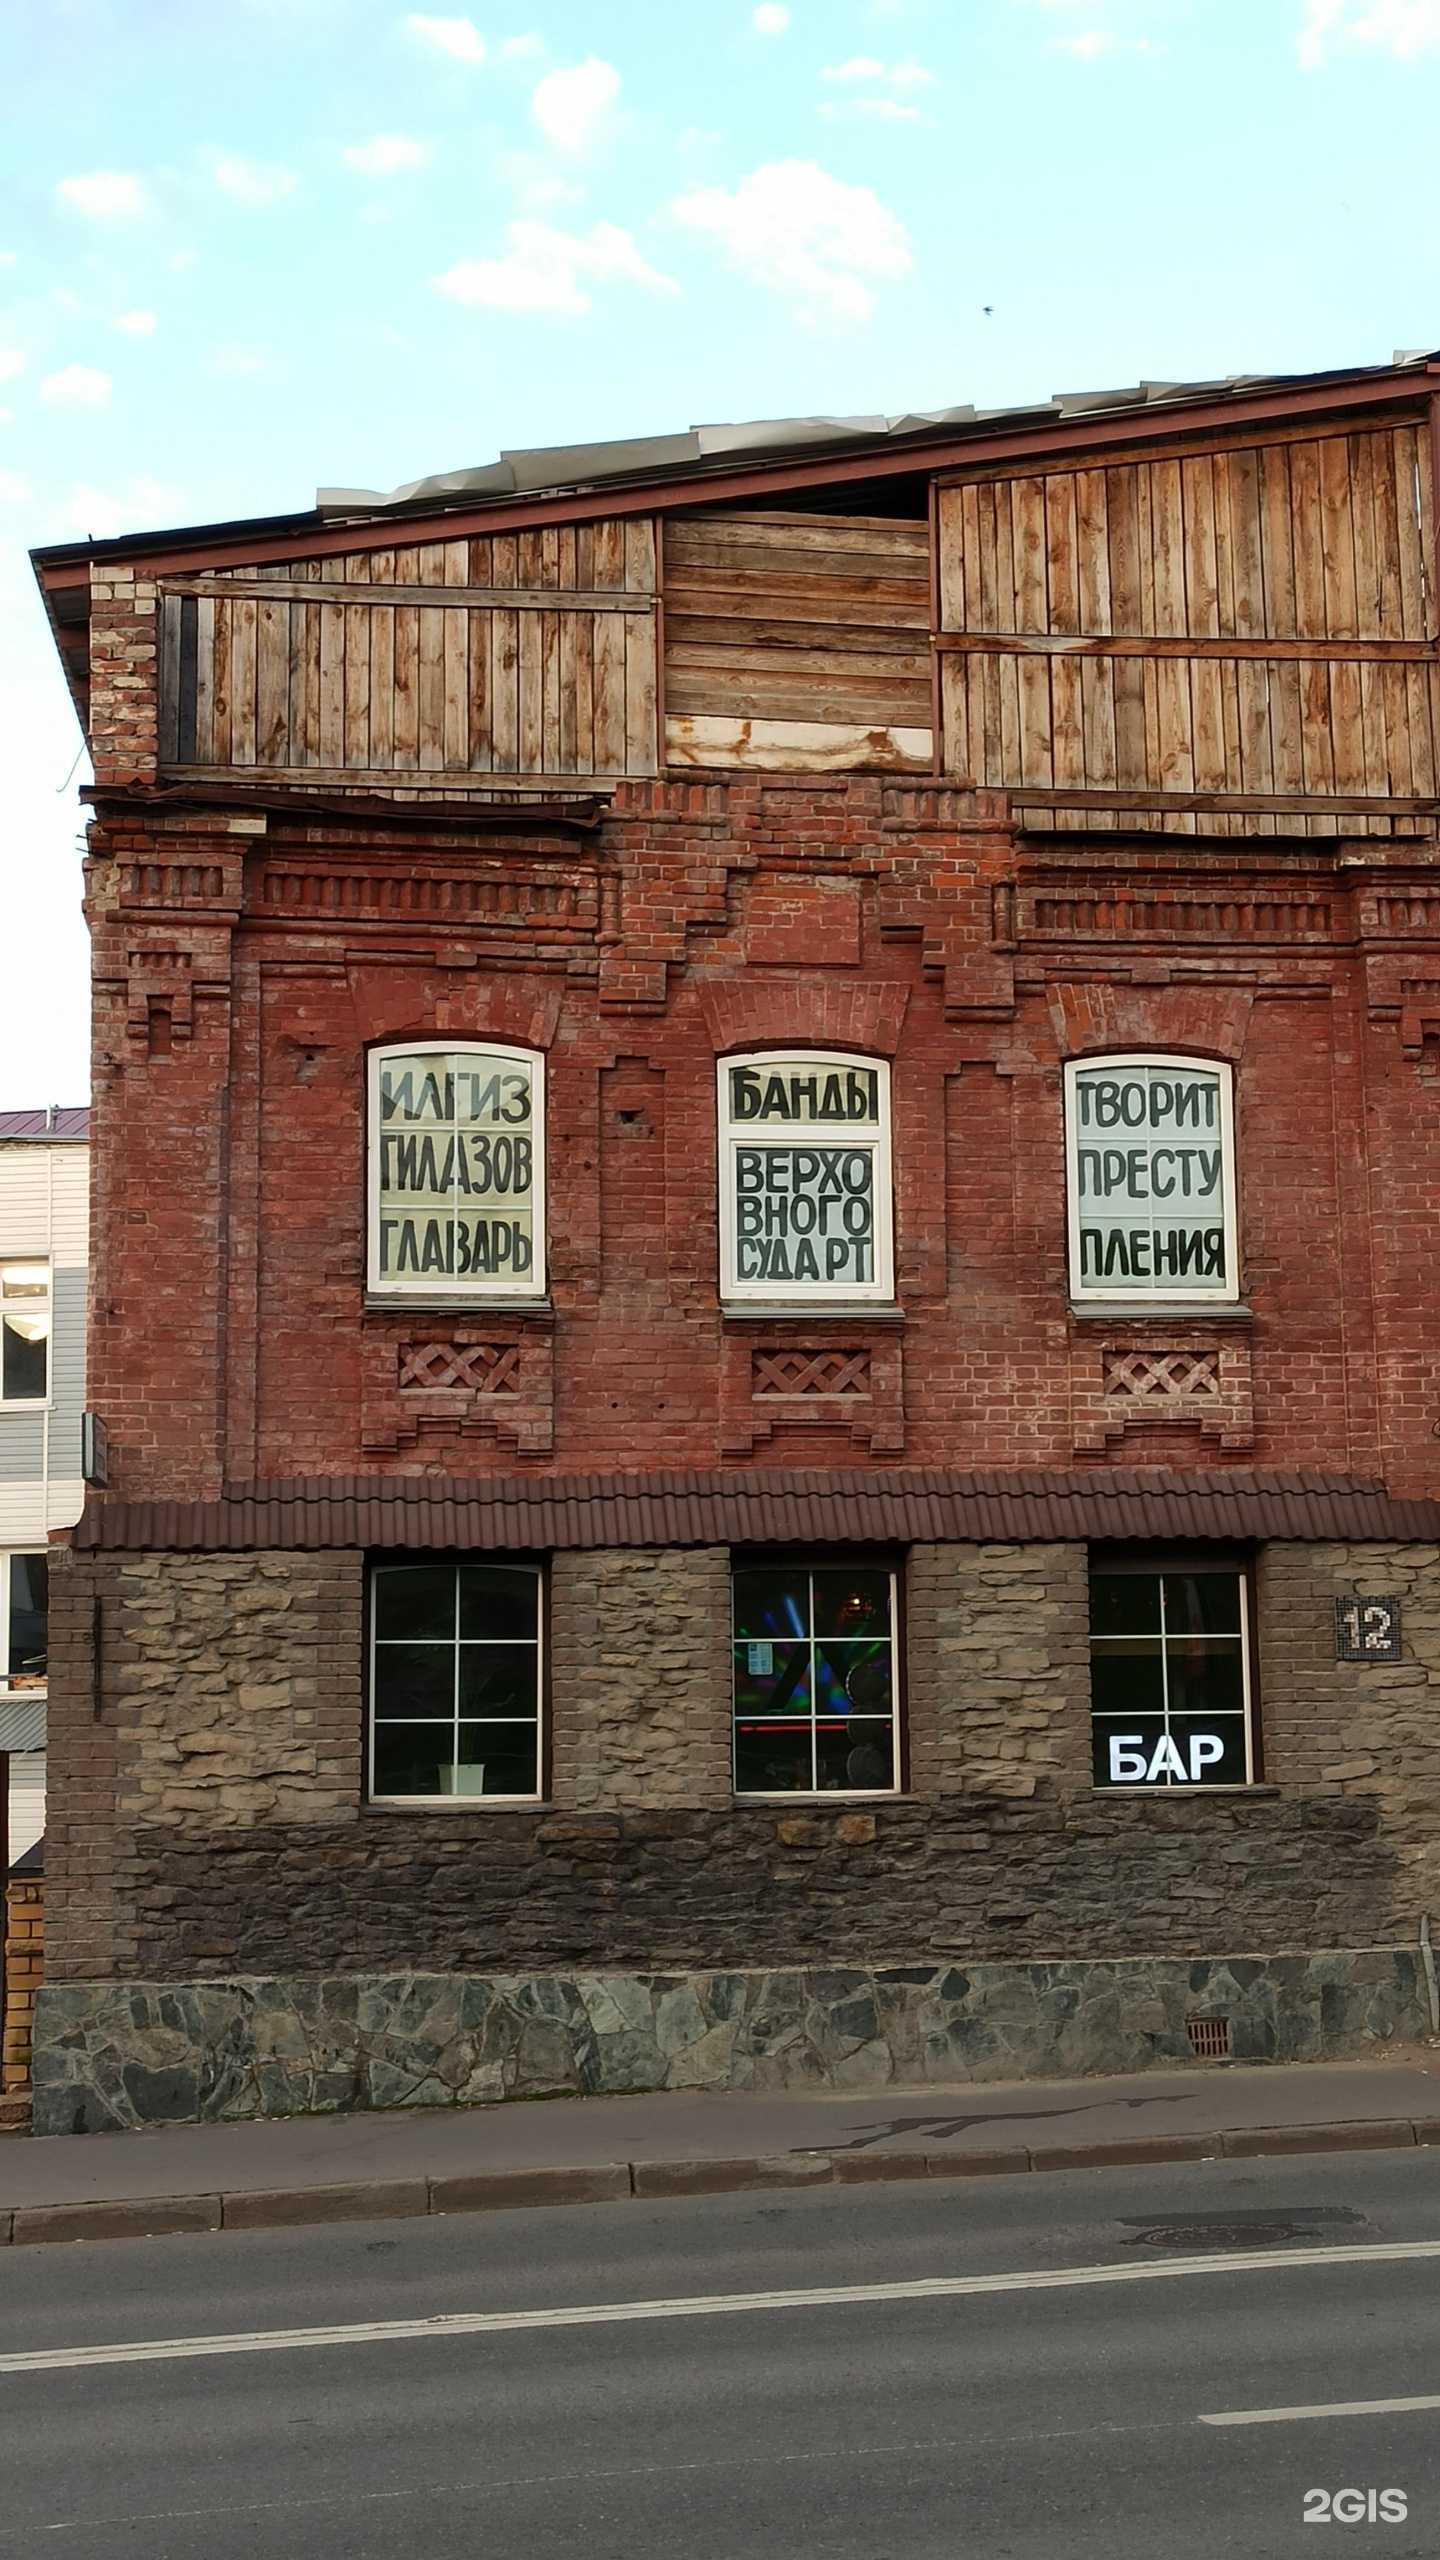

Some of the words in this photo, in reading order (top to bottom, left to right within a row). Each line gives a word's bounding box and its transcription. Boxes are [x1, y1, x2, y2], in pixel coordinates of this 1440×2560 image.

[733, 1070, 879, 1120] БАНДЫ
[1077, 1081, 1219, 1127] ТВОРИТ
[381, 1135, 532, 1194] ГИЛАЗОВ
[737, 1151, 872, 1194] ВЕРХО
[1078, 1149, 1222, 1198] ПРЕСТУ
[737, 1194, 871, 1236] ВНОГО
[381, 1220, 532, 1274] ГЛАВАРЬ
[1080, 1228, 1225, 1278] ПЛЕНИЯ
[1344, 1606, 1391, 1649] 12
[1109, 1735, 1224, 1781] БАР
